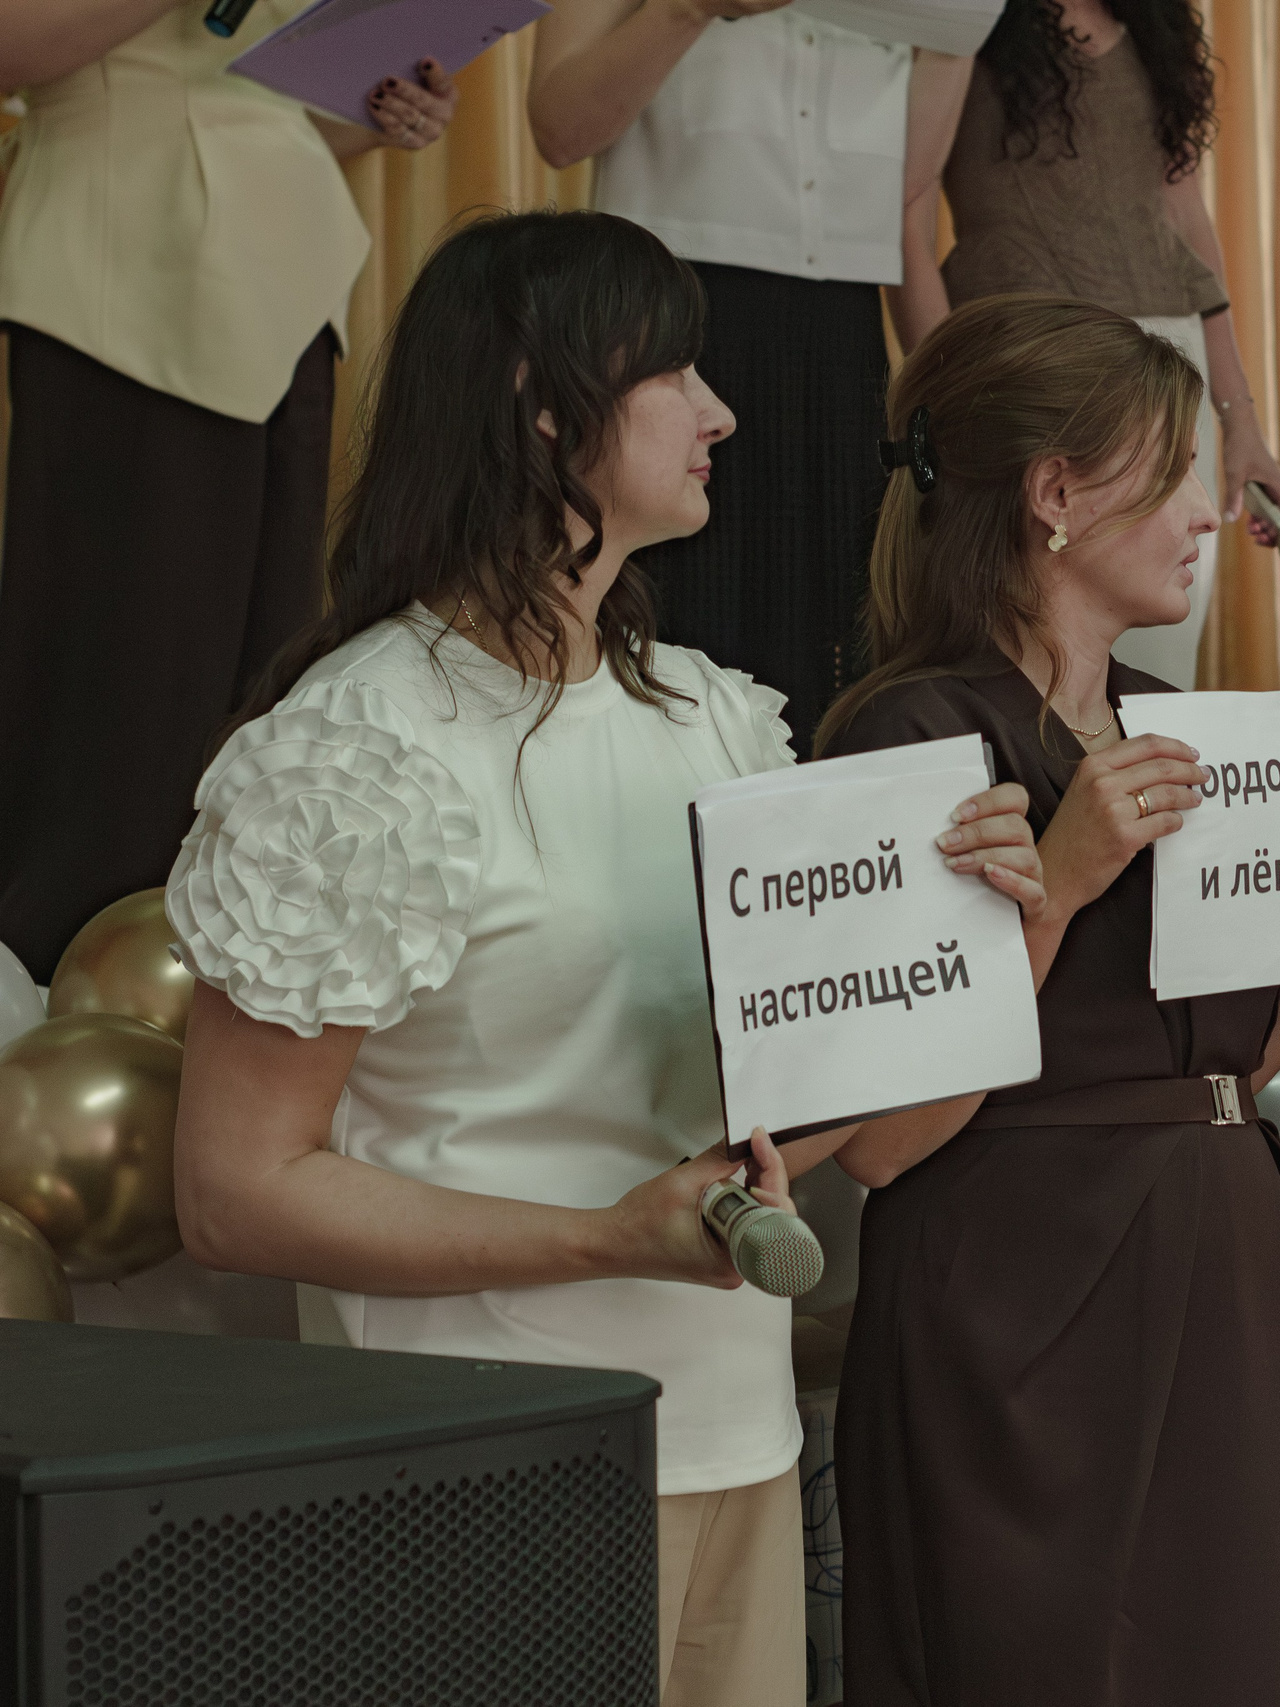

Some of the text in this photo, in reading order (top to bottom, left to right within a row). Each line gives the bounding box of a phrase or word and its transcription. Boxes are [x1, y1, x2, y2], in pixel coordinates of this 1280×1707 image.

[729, 838, 904, 918] С первой
[1200, 865, 1220, 901] и
[739, 939, 971, 1033] настоящей
